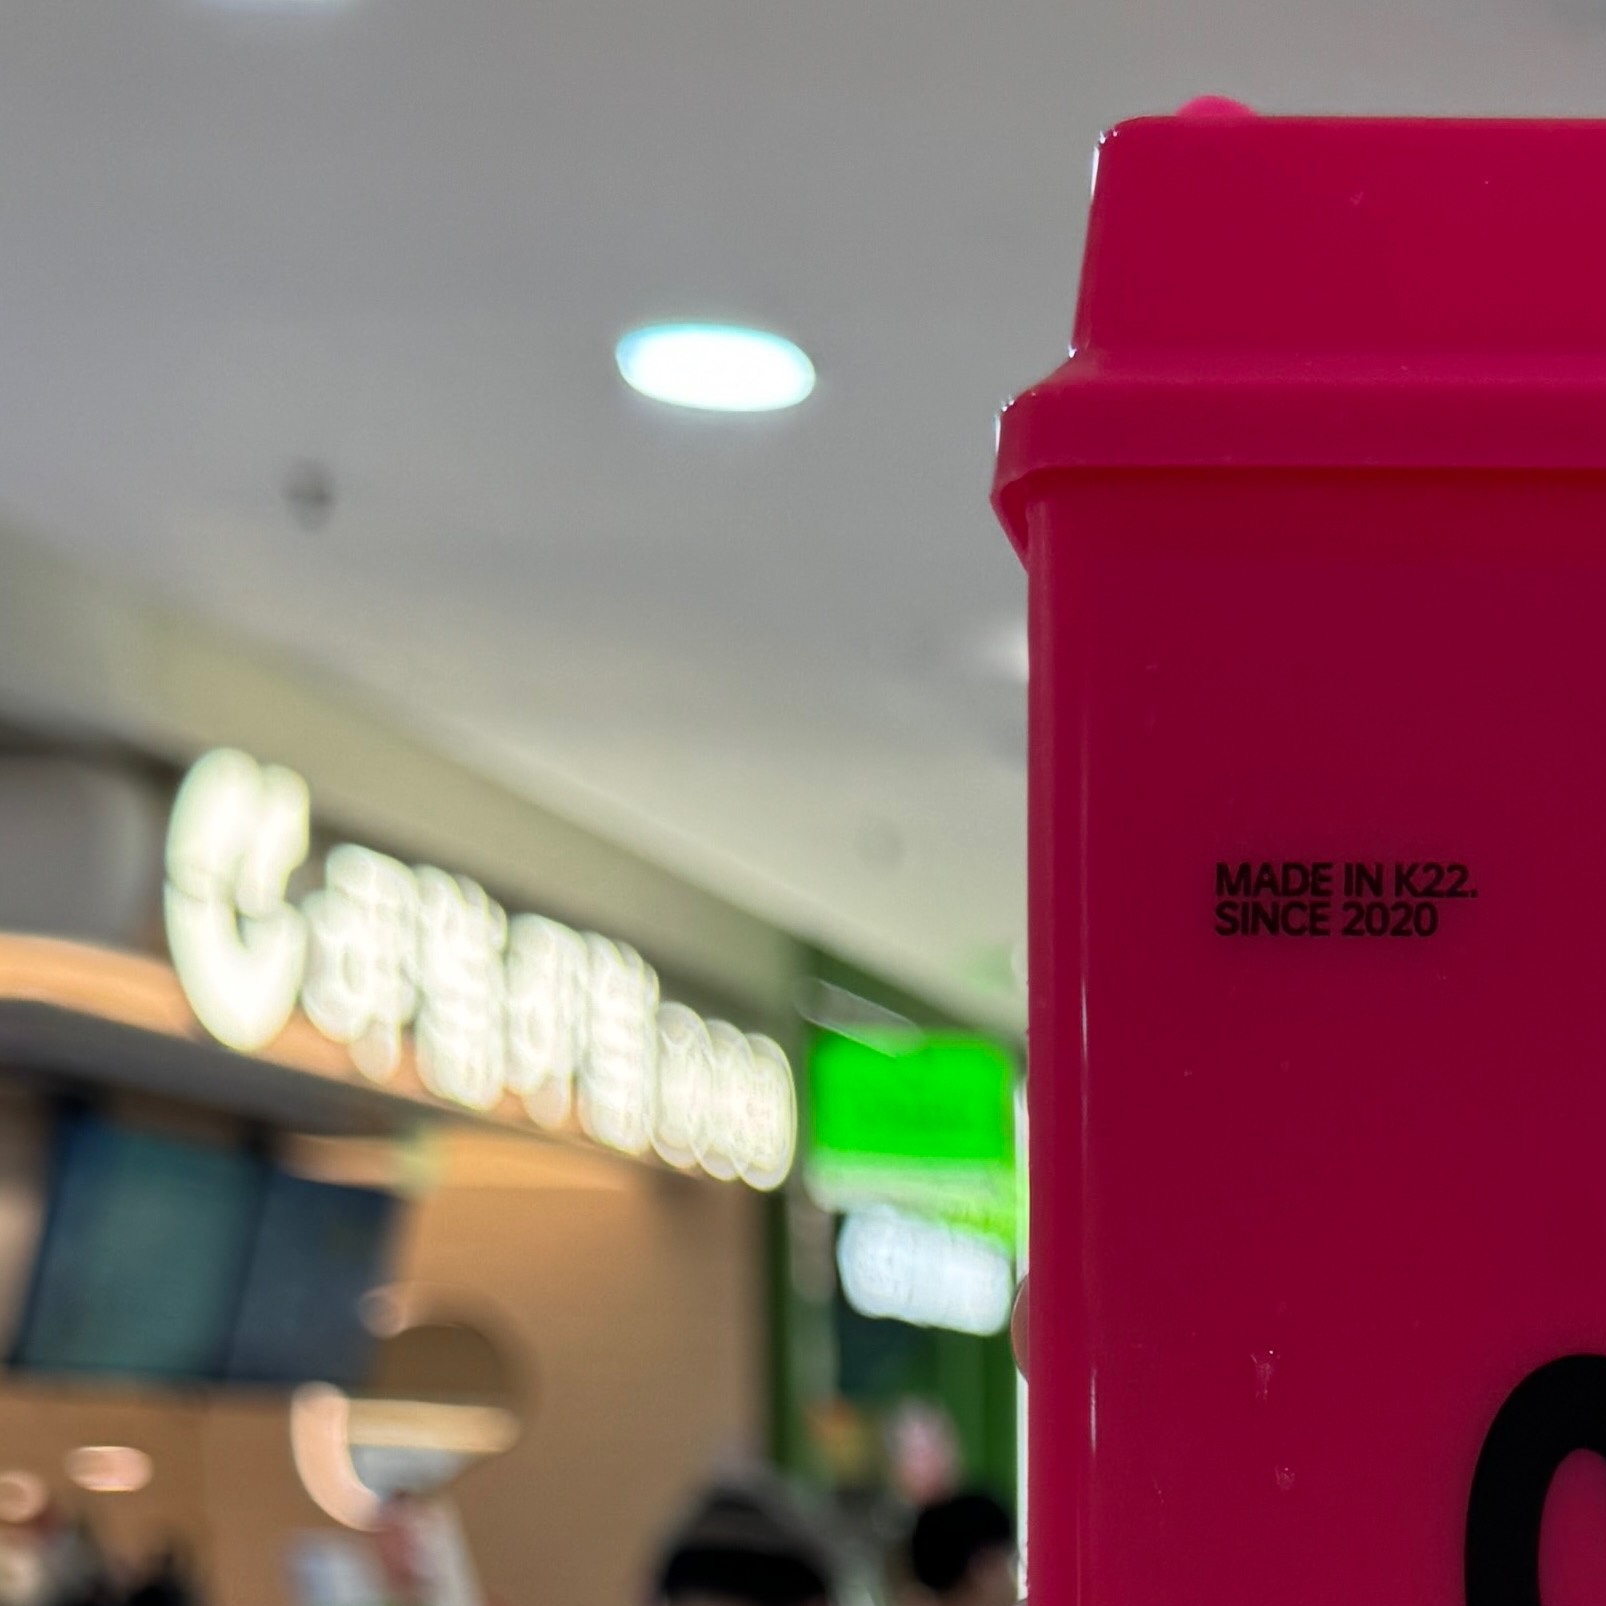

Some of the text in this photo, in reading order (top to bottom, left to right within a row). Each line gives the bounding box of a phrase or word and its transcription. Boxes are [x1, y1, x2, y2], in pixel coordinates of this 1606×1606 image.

[1215, 862, 1478, 898] MADE IN K22.
[1214, 901, 1438, 936] SINCE 2020
